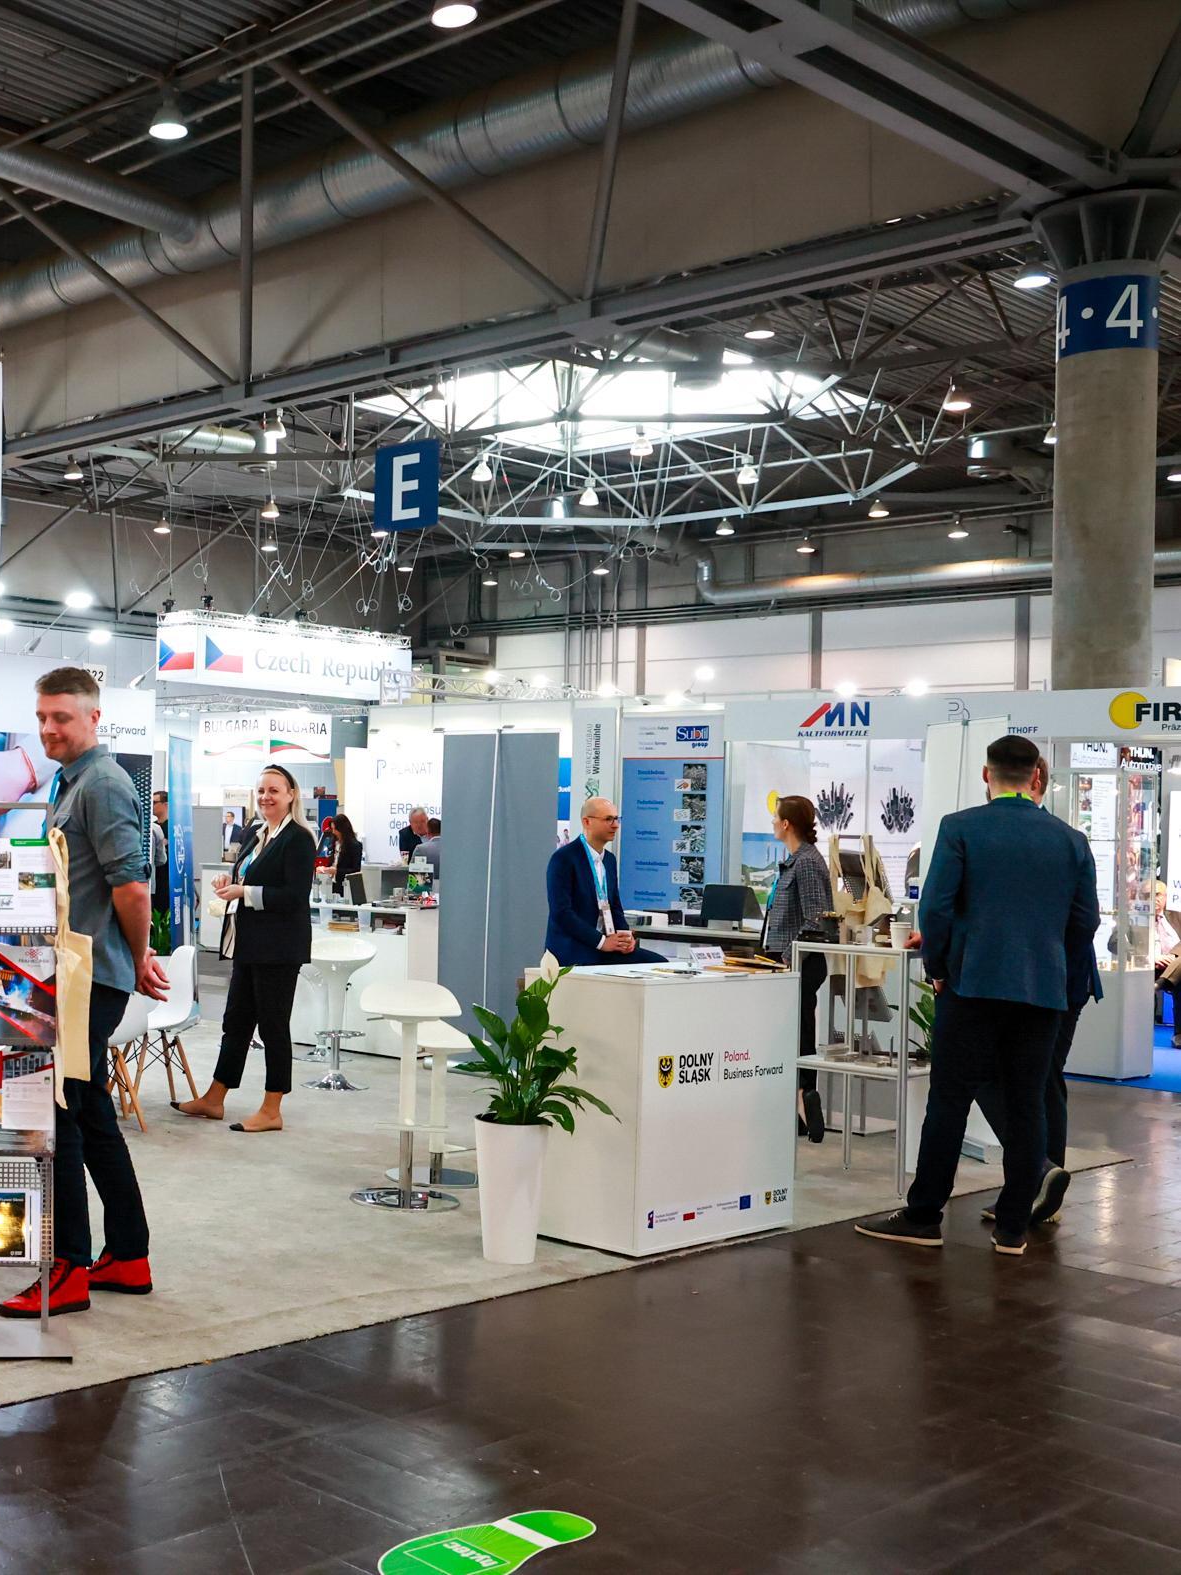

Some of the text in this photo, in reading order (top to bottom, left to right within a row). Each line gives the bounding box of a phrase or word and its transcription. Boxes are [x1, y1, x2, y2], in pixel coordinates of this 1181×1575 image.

[1106, 285, 1143, 338] 4
[392, 453, 420, 521] E
[254, 648, 401, 685] Czech Republic
[110, 723, 147, 736] Forward
[204, 719, 260, 733] BULGARIA
[270, 719, 328, 735] BULGARIA
[797, 730, 870, 738] KALTFORMTEILE
[592, 723, 601, 775] Winkelmühle
[679, 1052, 714, 1069] DOLNY
[724, 1049, 751, 1062] Poland.
[678, 1066, 711, 1085] ŚLĄSK
[723, 1063, 784, 1080] Business Forward
